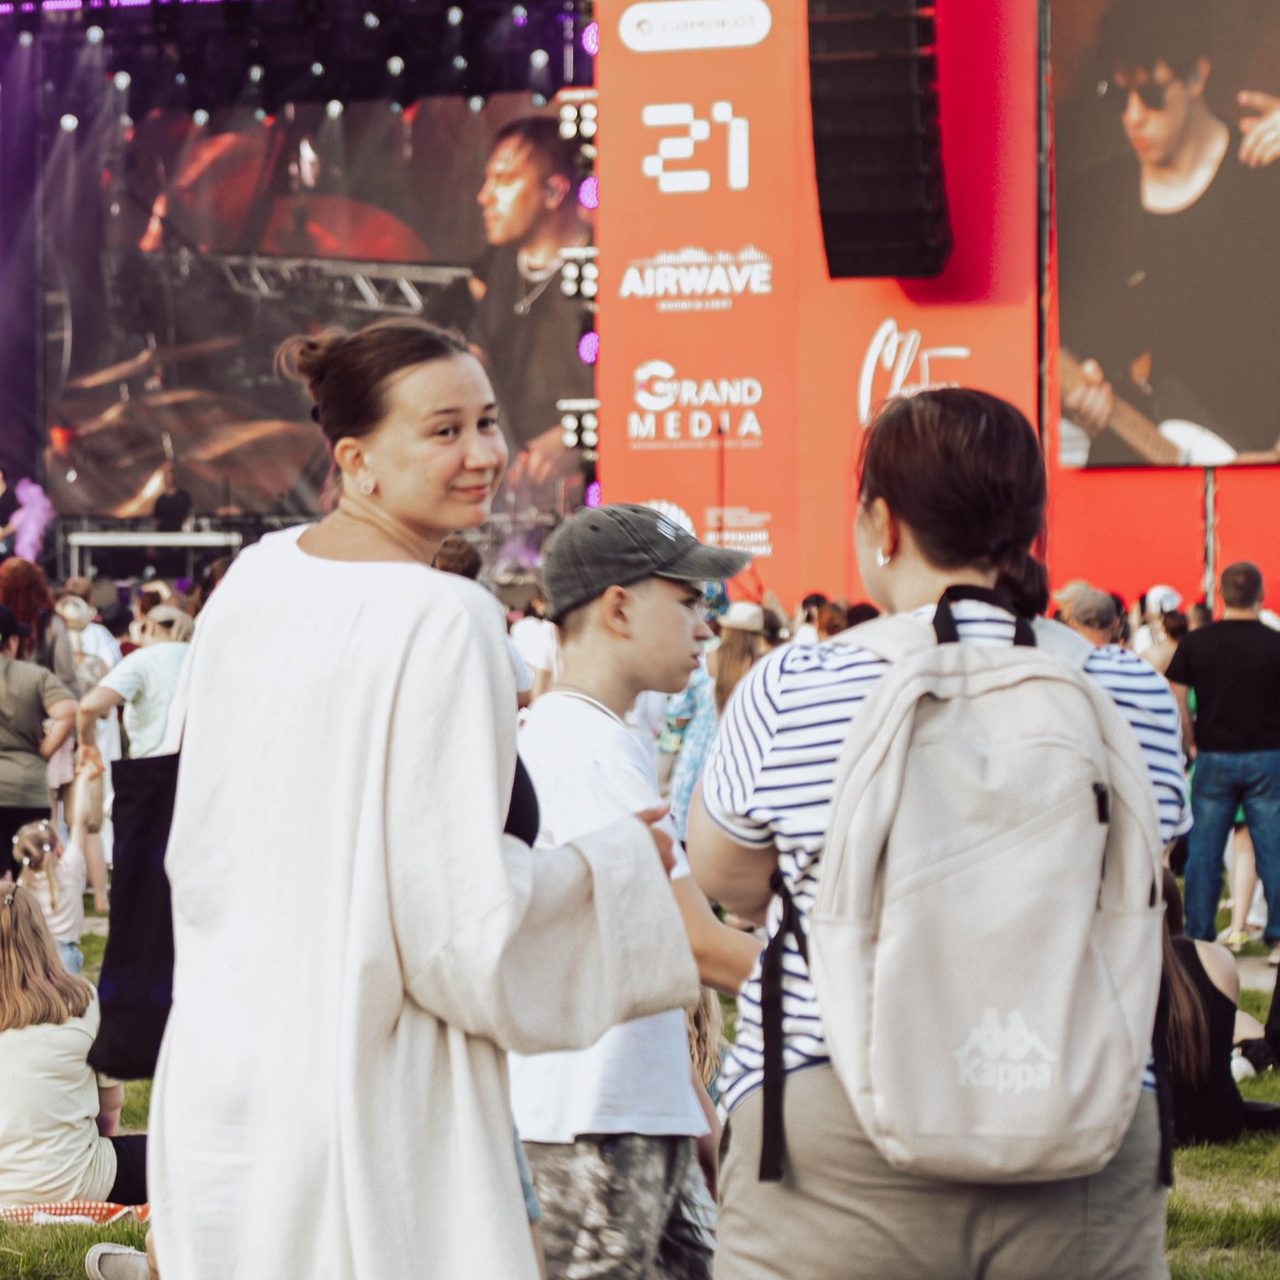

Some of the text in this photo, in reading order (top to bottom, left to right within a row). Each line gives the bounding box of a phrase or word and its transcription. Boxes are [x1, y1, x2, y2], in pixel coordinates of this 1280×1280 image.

[641, 101, 749, 194] 21
[619, 261, 773, 298] AIRWAVE
[627, 410, 762, 439] MEDIA
[957, 1057, 1052, 1095] Kappa
